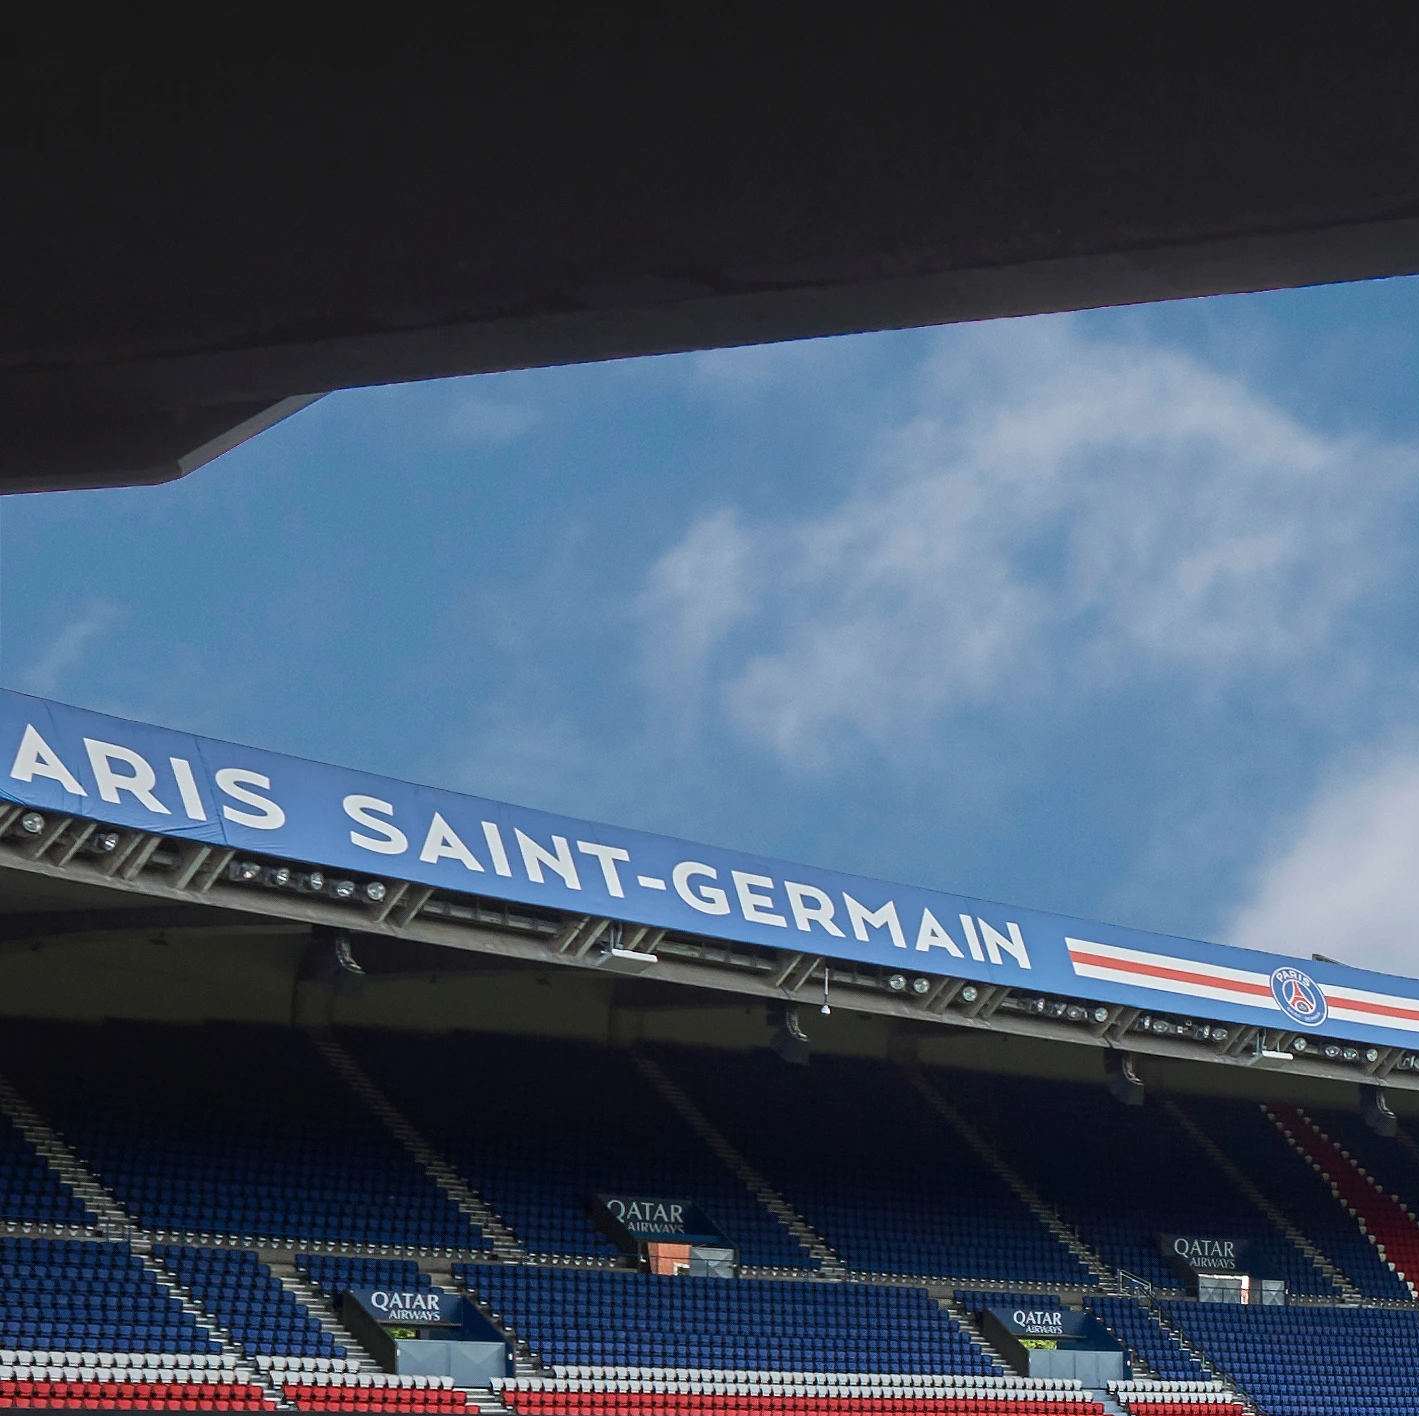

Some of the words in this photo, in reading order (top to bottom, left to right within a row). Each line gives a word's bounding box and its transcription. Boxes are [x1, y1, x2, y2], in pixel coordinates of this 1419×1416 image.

[11, 723, 286, 830] ARIS
[343, 794, 1032, 970] SAINT-GERMAIN
[1276, 970, 1310, 986] PARIS
[628, 1221, 685, 1234] AIRWAYS
[1174, 1238, 1234, 1258] QATAR
[1190, 1256, 1236, 1270] AIRWAYS
[371, 1291, 440, 1312] QATAR
[389, 1309, 441, 1321] AIRWAYS
[1013, 1310, 1062, 1326] QATAR
